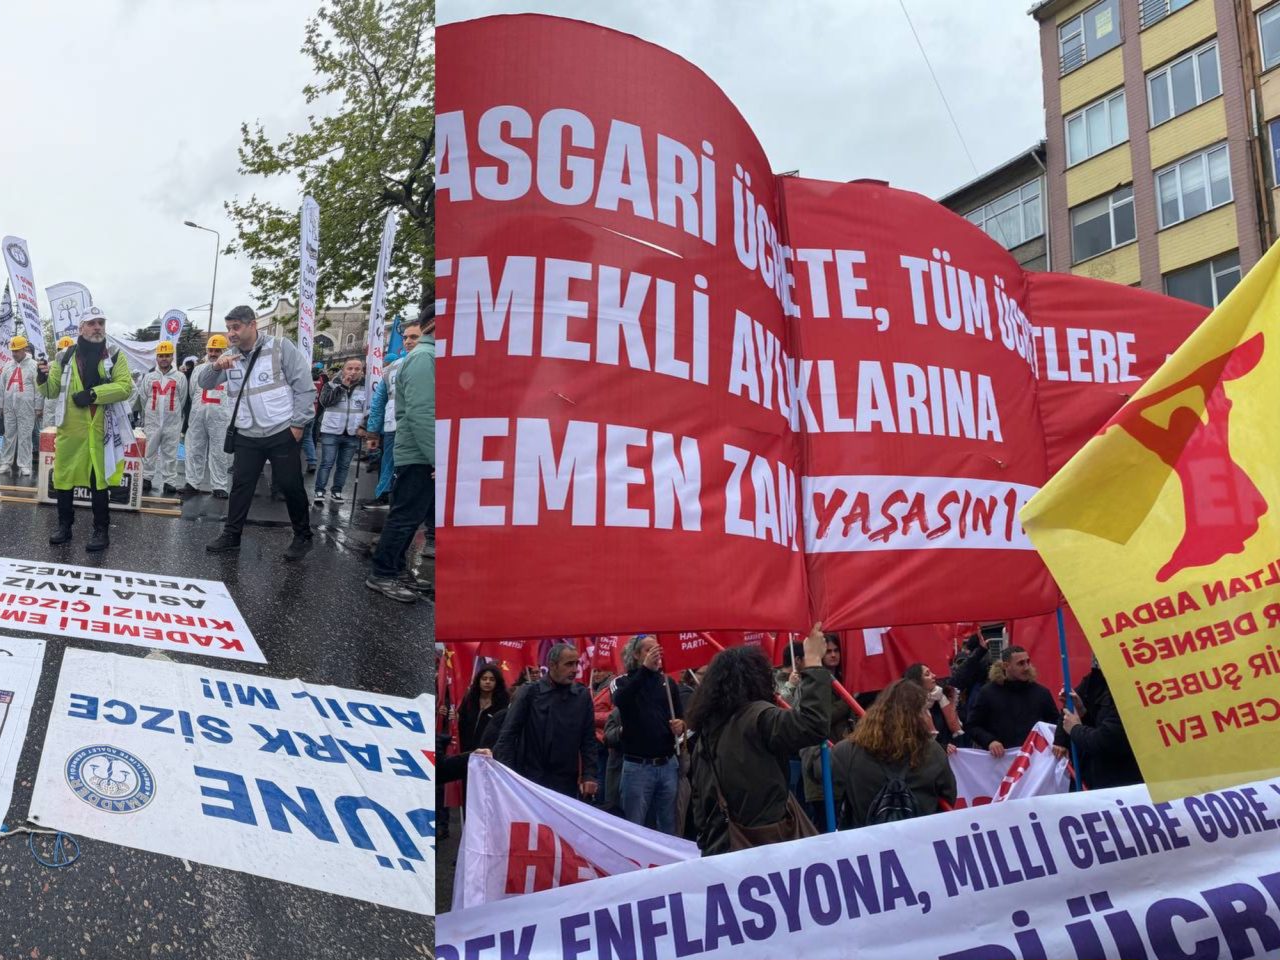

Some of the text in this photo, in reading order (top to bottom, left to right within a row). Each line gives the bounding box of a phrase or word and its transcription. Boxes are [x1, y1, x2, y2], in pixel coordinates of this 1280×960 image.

[435, 104, 992, 342] ASGARİ TÜM
[6, 367, 24, 392] A
[151, 380, 177, 411] M
[814, 489, 991, 543] YAŞASIN
[2, 576, 207, 609] ASLA TAVİZ
[59, 617, 245, 652] KADEMELİ
[103, 604, 233, 632] KIRMIZI
[199, 678, 426, 734] ADİL Mİ!
[67, 693, 431, 781] FARK SİZCE
[70, 778, 150, 812] EMADDER
[560, 849, 931, 960] ENFLASYONA,
[933, 812, 1058, 898] MİLLİ
[1059, 799, 1190, 870] GELİRE
